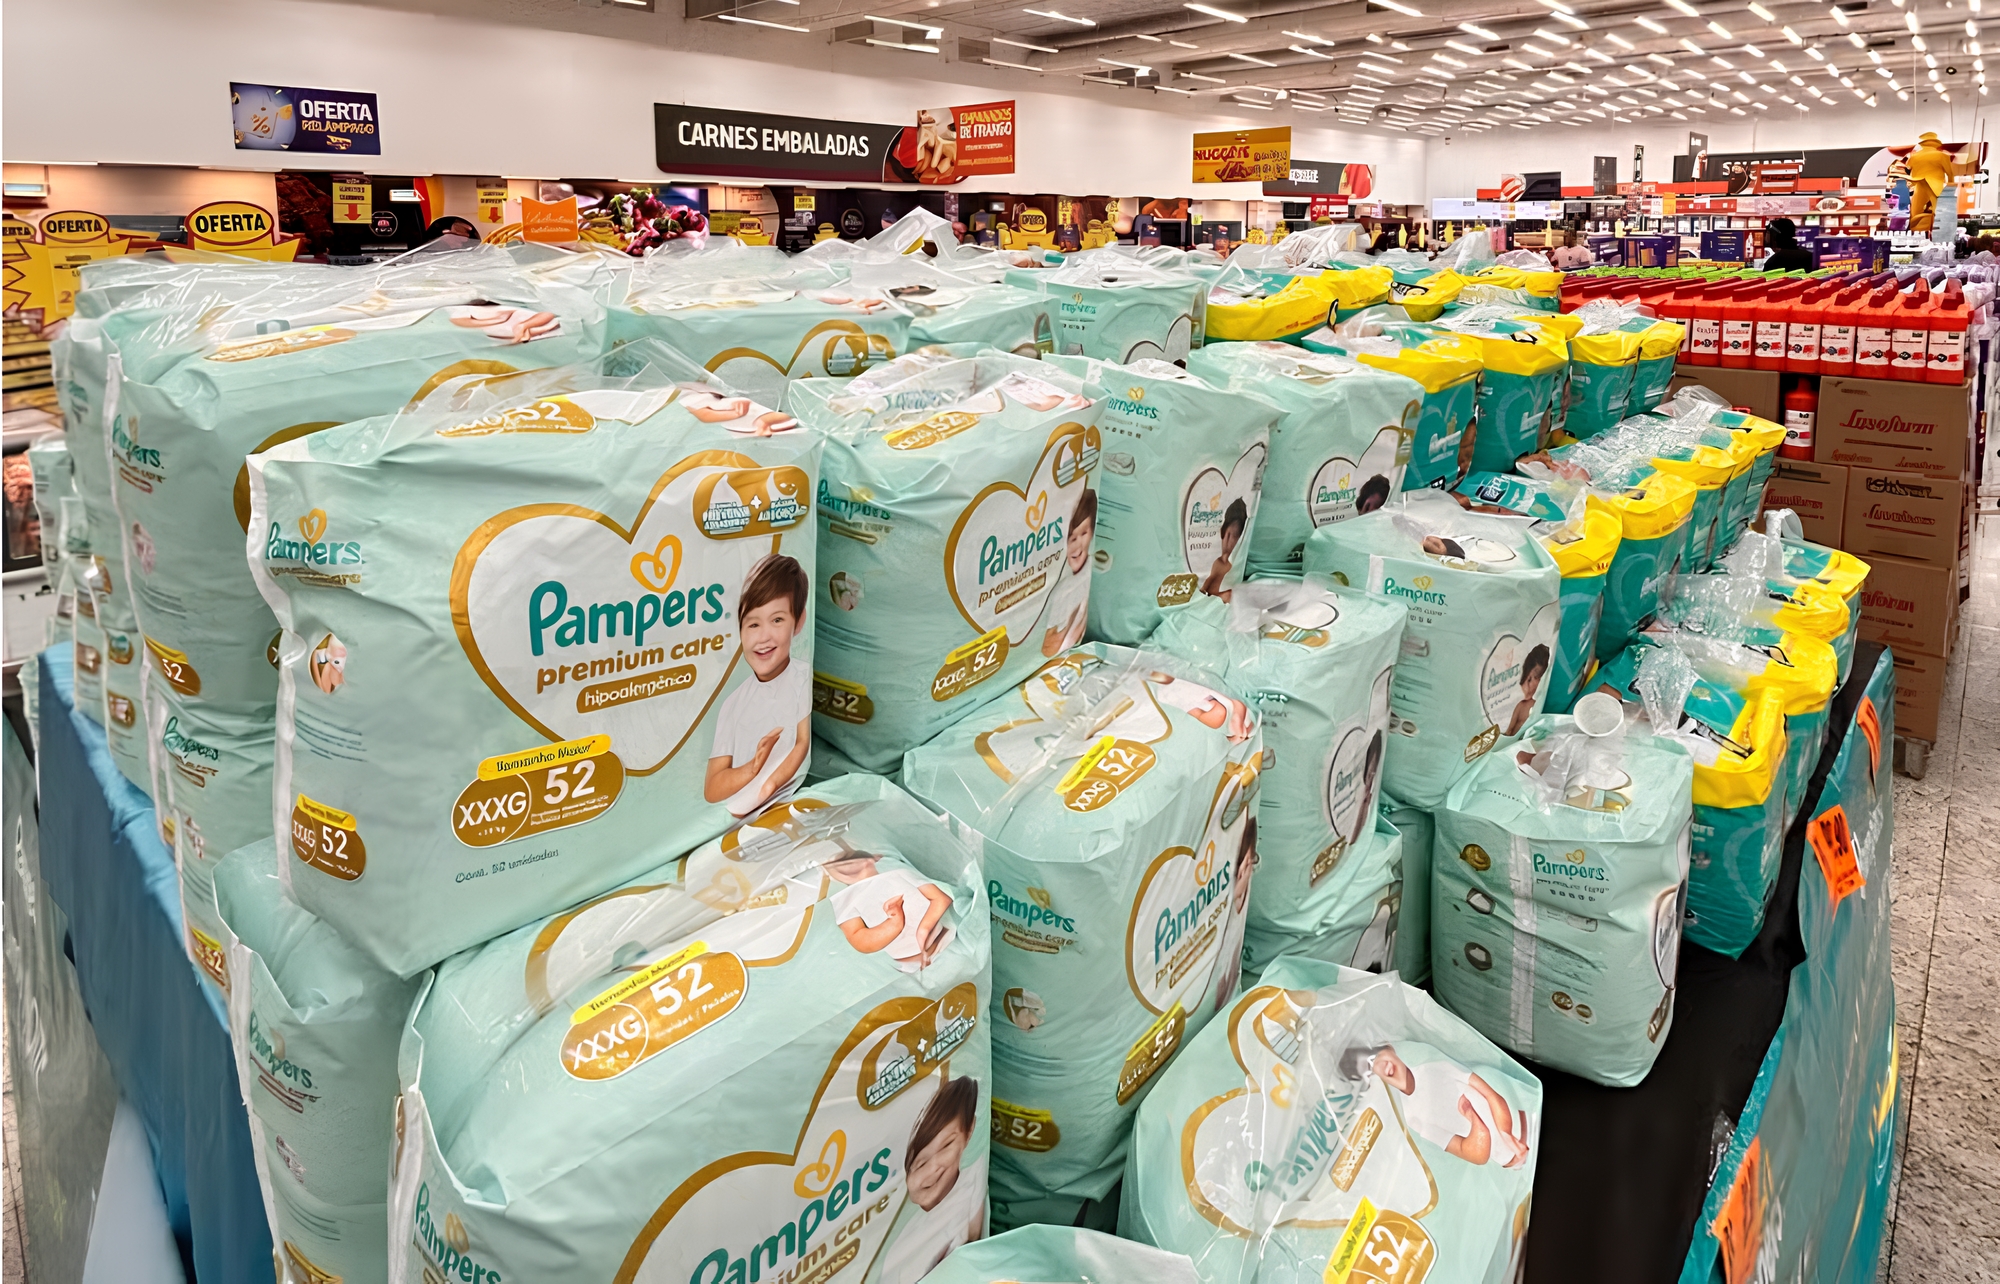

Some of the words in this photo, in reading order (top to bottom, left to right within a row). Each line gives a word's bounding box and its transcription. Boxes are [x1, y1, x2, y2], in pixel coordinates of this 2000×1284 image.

[300, 99, 373, 121] OFERTA
[678, 121, 758, 150] CARNES
[762, 128, 869, 157] EMBALADAS
[46, 219, 103, 234] OFERTA
[195, 213, 266, 233] OFERTA
[978, 516, 1063, 585] Pampers
[528, 581, 726, 657] Pampers
[536, 644, 664, 694] premium
[670, 633, 726, 661] care
[973, 642, 998, 672] 52
[832, 689, 859, 713] 52
[1097, 747, 1138, 776] 52
[543, 759, 596, 805] 52
[458, 791, 527, 829] XXXG
[322, 825, 349, 860] 52
[1533, 853, 1605, 881] Pampers
[988, 880, 1076, 933] Pampers
[1154, 860, 1231, 966] Pampers
[650, 962, 714, 1016] 52
[566, 1013, 642, 1071] XXXG
[1152, 1017, 1176, 1060] 52
[1010, 1117, 1043, 1141] 52
[834, 1193, 889, 1247] care
[1364, 1225, 1411, 1275] 52
